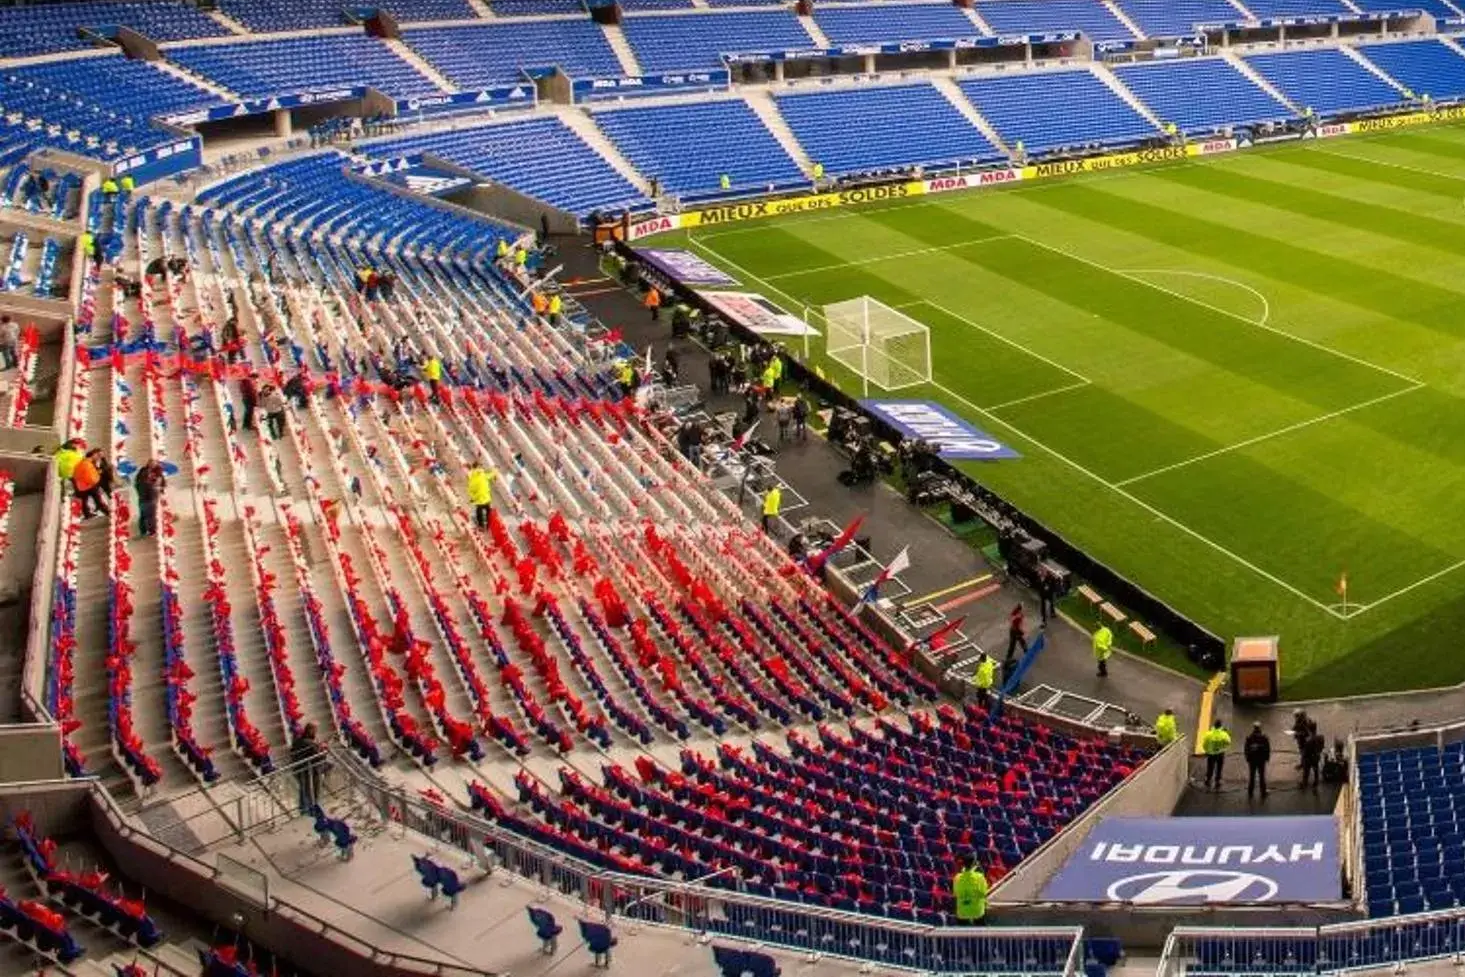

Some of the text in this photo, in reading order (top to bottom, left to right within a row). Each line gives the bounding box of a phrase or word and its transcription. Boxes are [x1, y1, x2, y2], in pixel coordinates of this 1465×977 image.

[1036, 160, 1086, 177] MIEUX
[1136, 147, 1189, 164] SOLDES
[929, 169, 1016, 192] MDA MDA
[699, 201, 769, 226] MIEUX
[838, 183, 909, 206] SOLDES
[633, 214, 673, 237] MDA
[1090, 840, 1324, 865] HYUNDAI
